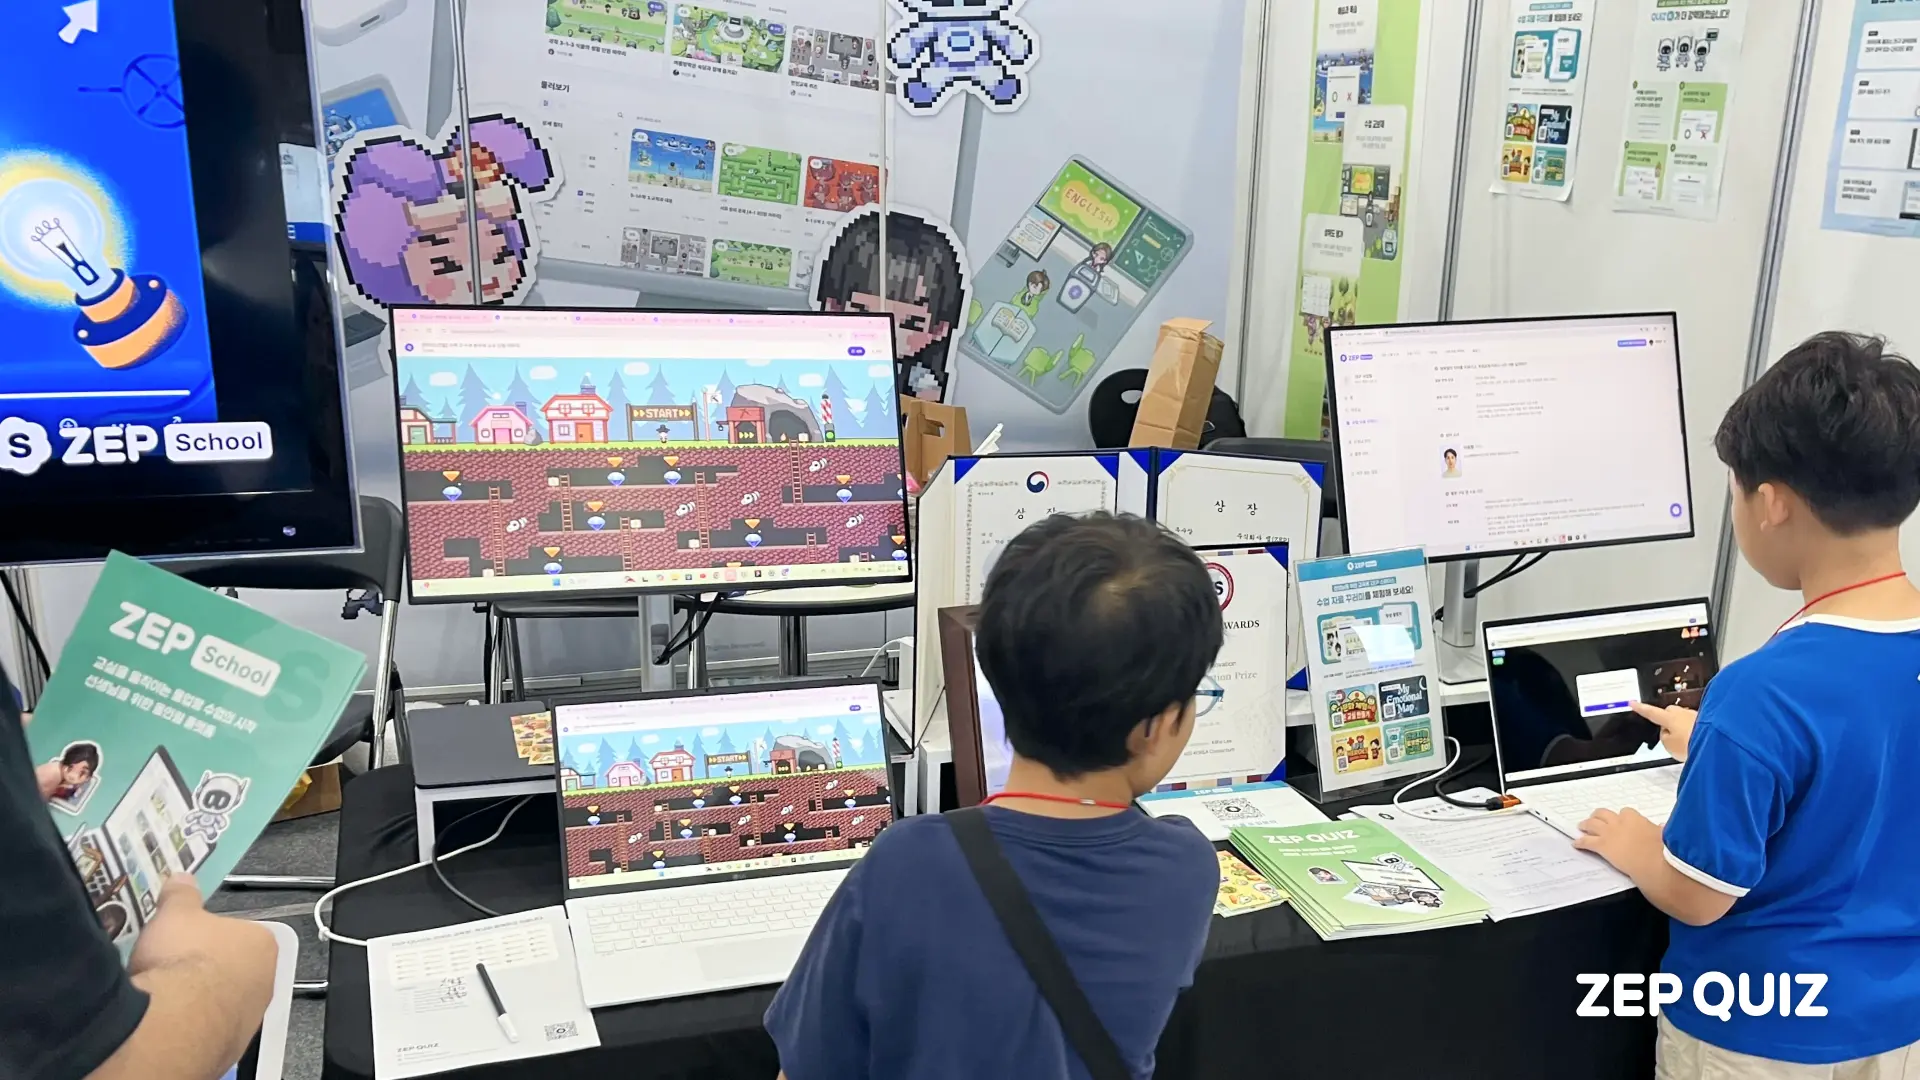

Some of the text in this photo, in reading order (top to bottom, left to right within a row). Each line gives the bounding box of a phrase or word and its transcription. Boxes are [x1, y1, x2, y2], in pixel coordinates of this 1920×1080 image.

[1065, 188, 1113, 226] ENGLISH
[645, 408, 679, 419] START
[59, 425, 159, 464] ZEP
[176, 432, 263, 452] School
[1317, 598, 1330, 607] 수업
[1331, 596, 1344, 604] 자료
[1393, 585, 1414, 596] 보세요!
[1224, 620, 1260, 630] WARDS
[109, 601, 272, 688] ZEP School
[1235, 671, 1258, 680] Prize
[1397, 684, 1410, 695] My
[1386, 691, 1423, 704] Emotional
[1397, 702, 1415, 714] Map
[716, 754, 739, 763] START
[1263, 829, 1360, 845] ZEP QUIZ
